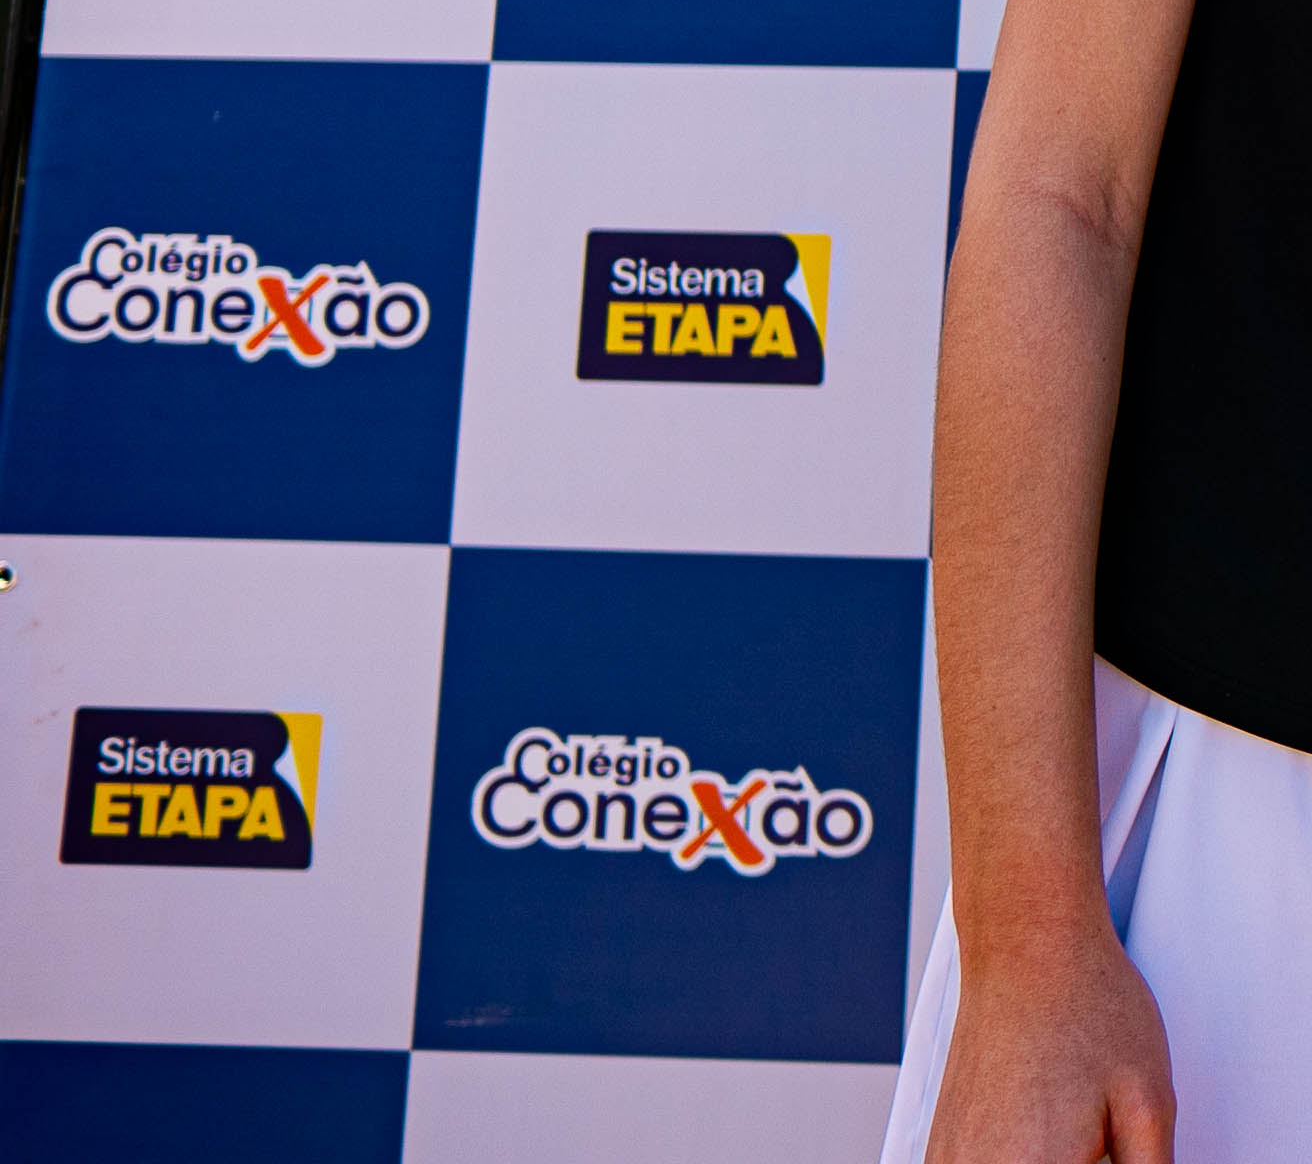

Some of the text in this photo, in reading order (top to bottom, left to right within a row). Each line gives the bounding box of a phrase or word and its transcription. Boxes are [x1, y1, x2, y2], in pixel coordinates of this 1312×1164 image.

[89, 235, 249, 284] Colégio
[611, 257, 764, 297] Sistema
[605, 301, 797, 357] ETAPA
[99, 737, 254, 776] Sistema
[513, 736, 682, 789] Colégio
[91, 782, 285, 840] ETAPA
